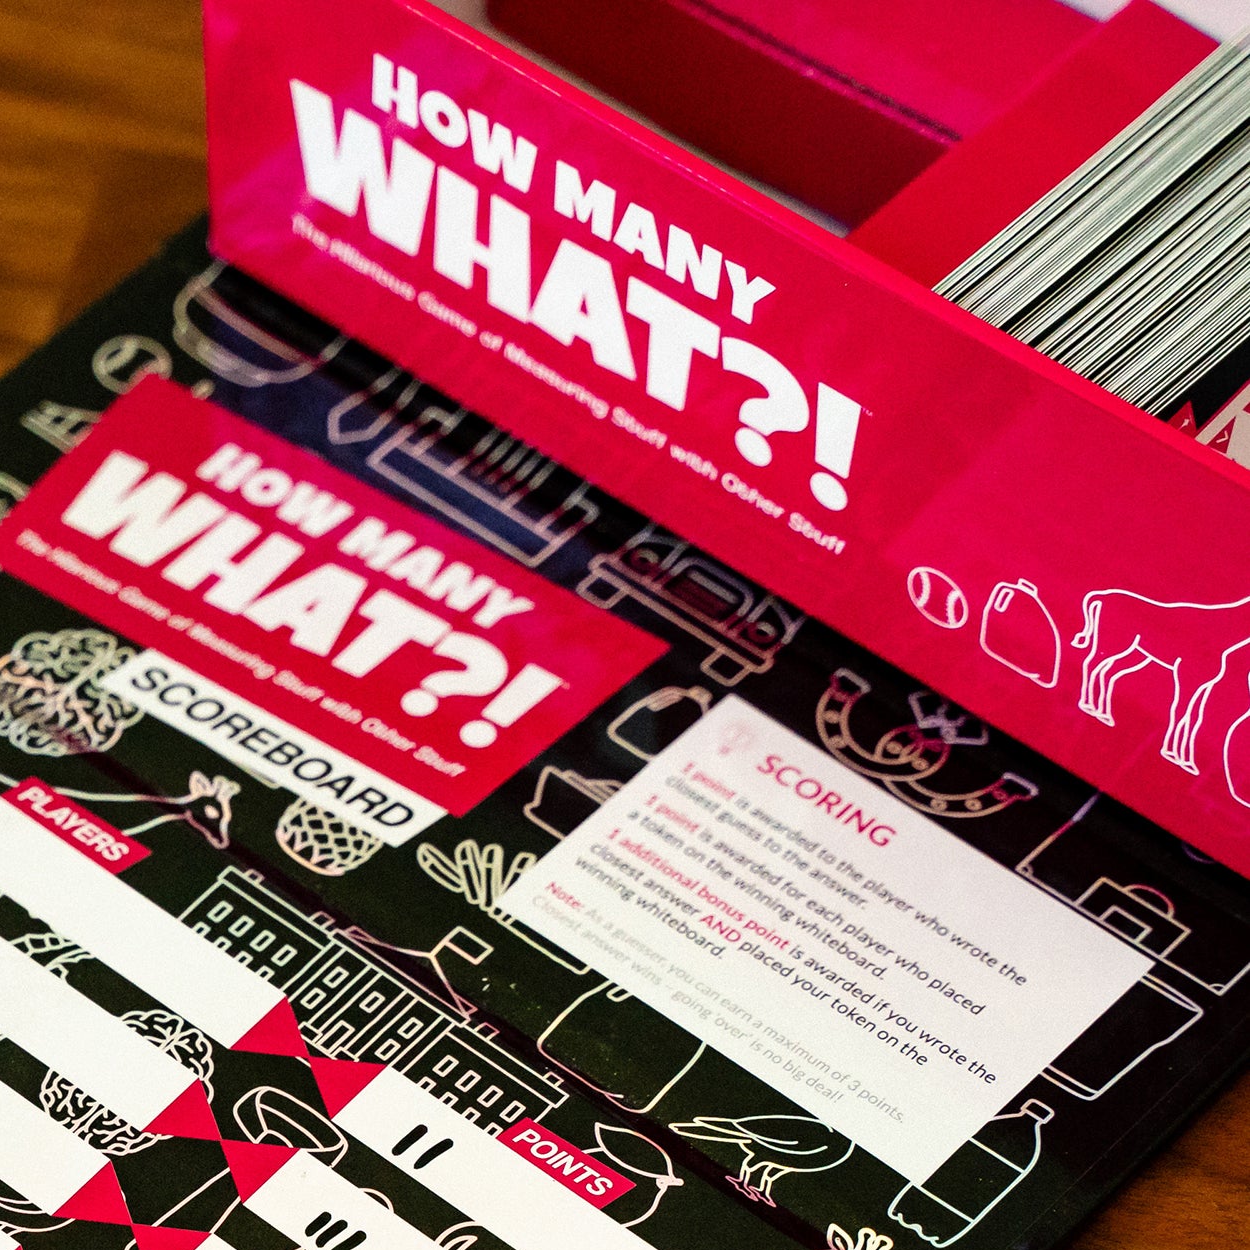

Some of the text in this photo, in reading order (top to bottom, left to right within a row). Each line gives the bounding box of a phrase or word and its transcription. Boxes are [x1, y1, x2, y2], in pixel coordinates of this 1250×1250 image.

[371, 53, 776, 325] HOW MANY
[290, 79, 862, 511] WHAT?!
[197, 443, 534, 628] HOW MANY
[610, 405, 668, 449] Stuff
[669, 444, 719, 481] with
[720, 471, 785, 519] Other
[787, 511, 846, 555] Stuff
[62, 450, 564, 748] WHAT?!
[17, 786, 129, 861] PLAYERS
[130, 666, 414, 828] SCOREBOARD
[360, 717, 417, 752] Other
[412, 745, 467, 778] Stuff
[756, 754, 897, 847] SCORING
[574, 856, 727, 960] winning whiteboard.
[589, 843, 929, 1066] closest answer AND placed your token on the
[639, 815, 685, 849] token
[682, 845, 707, 864] on
[705, 858, 734, 880] the
[732, 876, 796, 923] winning
[794, 916, 888, 981] whiteboard.
[712, 840, 785, 886] awarded
[779, 880, 808, 901] for
[804, 898, 845, 927] each
[840, 923, 895, 957] player
[894, 954, 930, 981] who
[926, 978, 987, 1016] placed
[749, 807, 822, 853] awarded
[816, 848, 837, 865] to
[835, 860, 864, 883] the
[860, 879, 915, 912] player
[913, 910, 950, 937] who
[949, 933, 999, 968] wrote
[997, 963, 1027, 986] the
[761, 836, 782, 854] to
[782, 848, 810, 871] the
[808, 868, 867, 909] answer.
[544, 880, 584, 909] Note:
[666, 963, 695, 985] you
[693, 980, 722, 1002] can
[718, 997, 754, 1023] earn
[751, 1019, 764, 1029] a
[761, 1025, 831, 1074] maximum
[829, 1070, 852, 1084] of
[846, 1079, 862, 1092] 3
[855, 1088, 904, 1124] points.
[579, 928, 632, 963] answer
[630, 960, 663, 986] wins
[669, 989, 714, 1021] going
[748, 1037, 764, 1052] is
[761, 1048, 783, 1065] no
[781, 1058, 807, 1082] big
[804, 1076, 845, 1103] deal!
[617, 837, 701, 891] additional
[695, 884, 746, 923] bonus
[741, 918, 790, 951] point
[787, 944, 805, 960] is
[802, 957, 877, 1005] awarded
[871, 998, 891, 1012] if
[884, 1009, 919, 1034] you
[918, 1029, 968, 1066] wrote
[966, 1060, 997, 1084] the
[512, 1128, 613, 1196] POINTS
